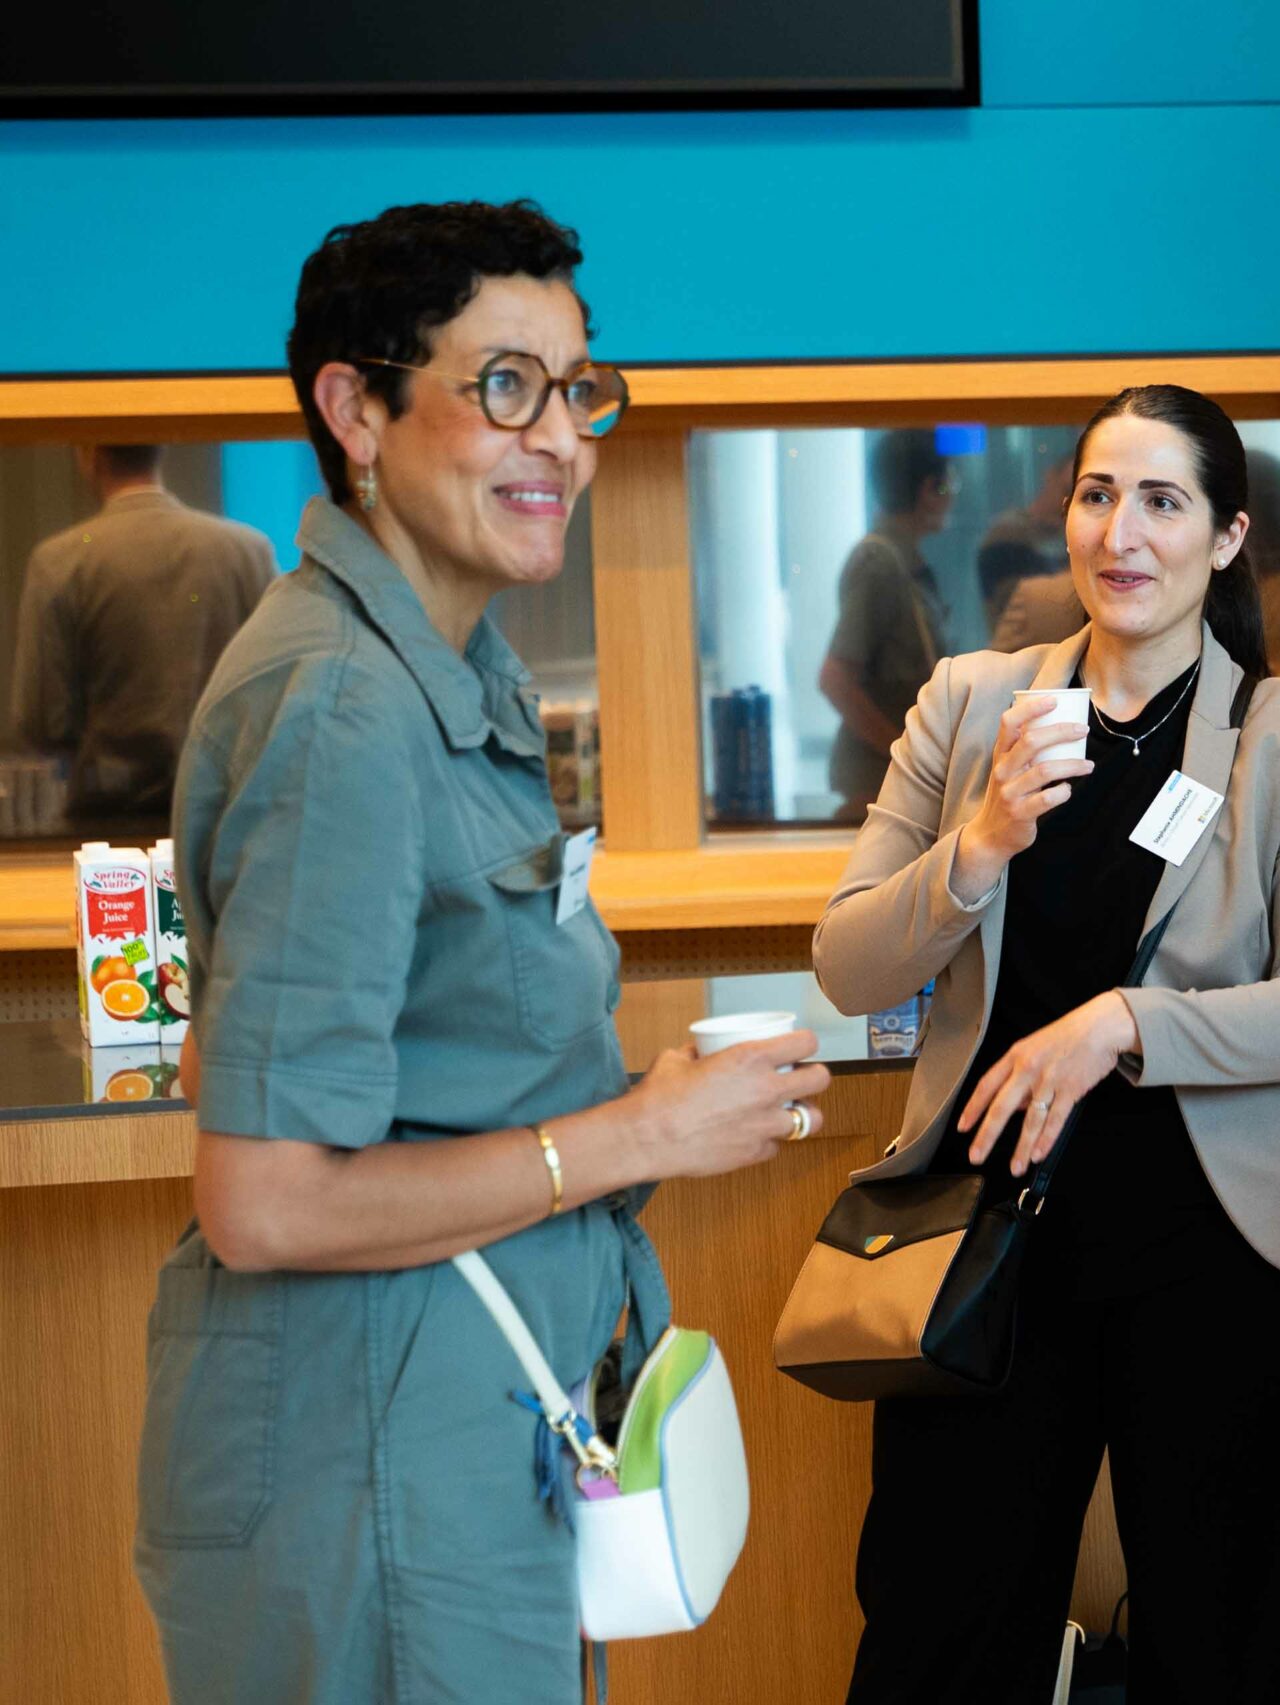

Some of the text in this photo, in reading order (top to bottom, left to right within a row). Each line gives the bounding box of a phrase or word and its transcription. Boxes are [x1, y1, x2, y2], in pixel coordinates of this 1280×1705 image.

[94, 870, 130, 880] Spring
[103, 880, 135, 889] Valley
[98, 900, 135, 912] Orange
[102, 912, 128, 925] Juice
